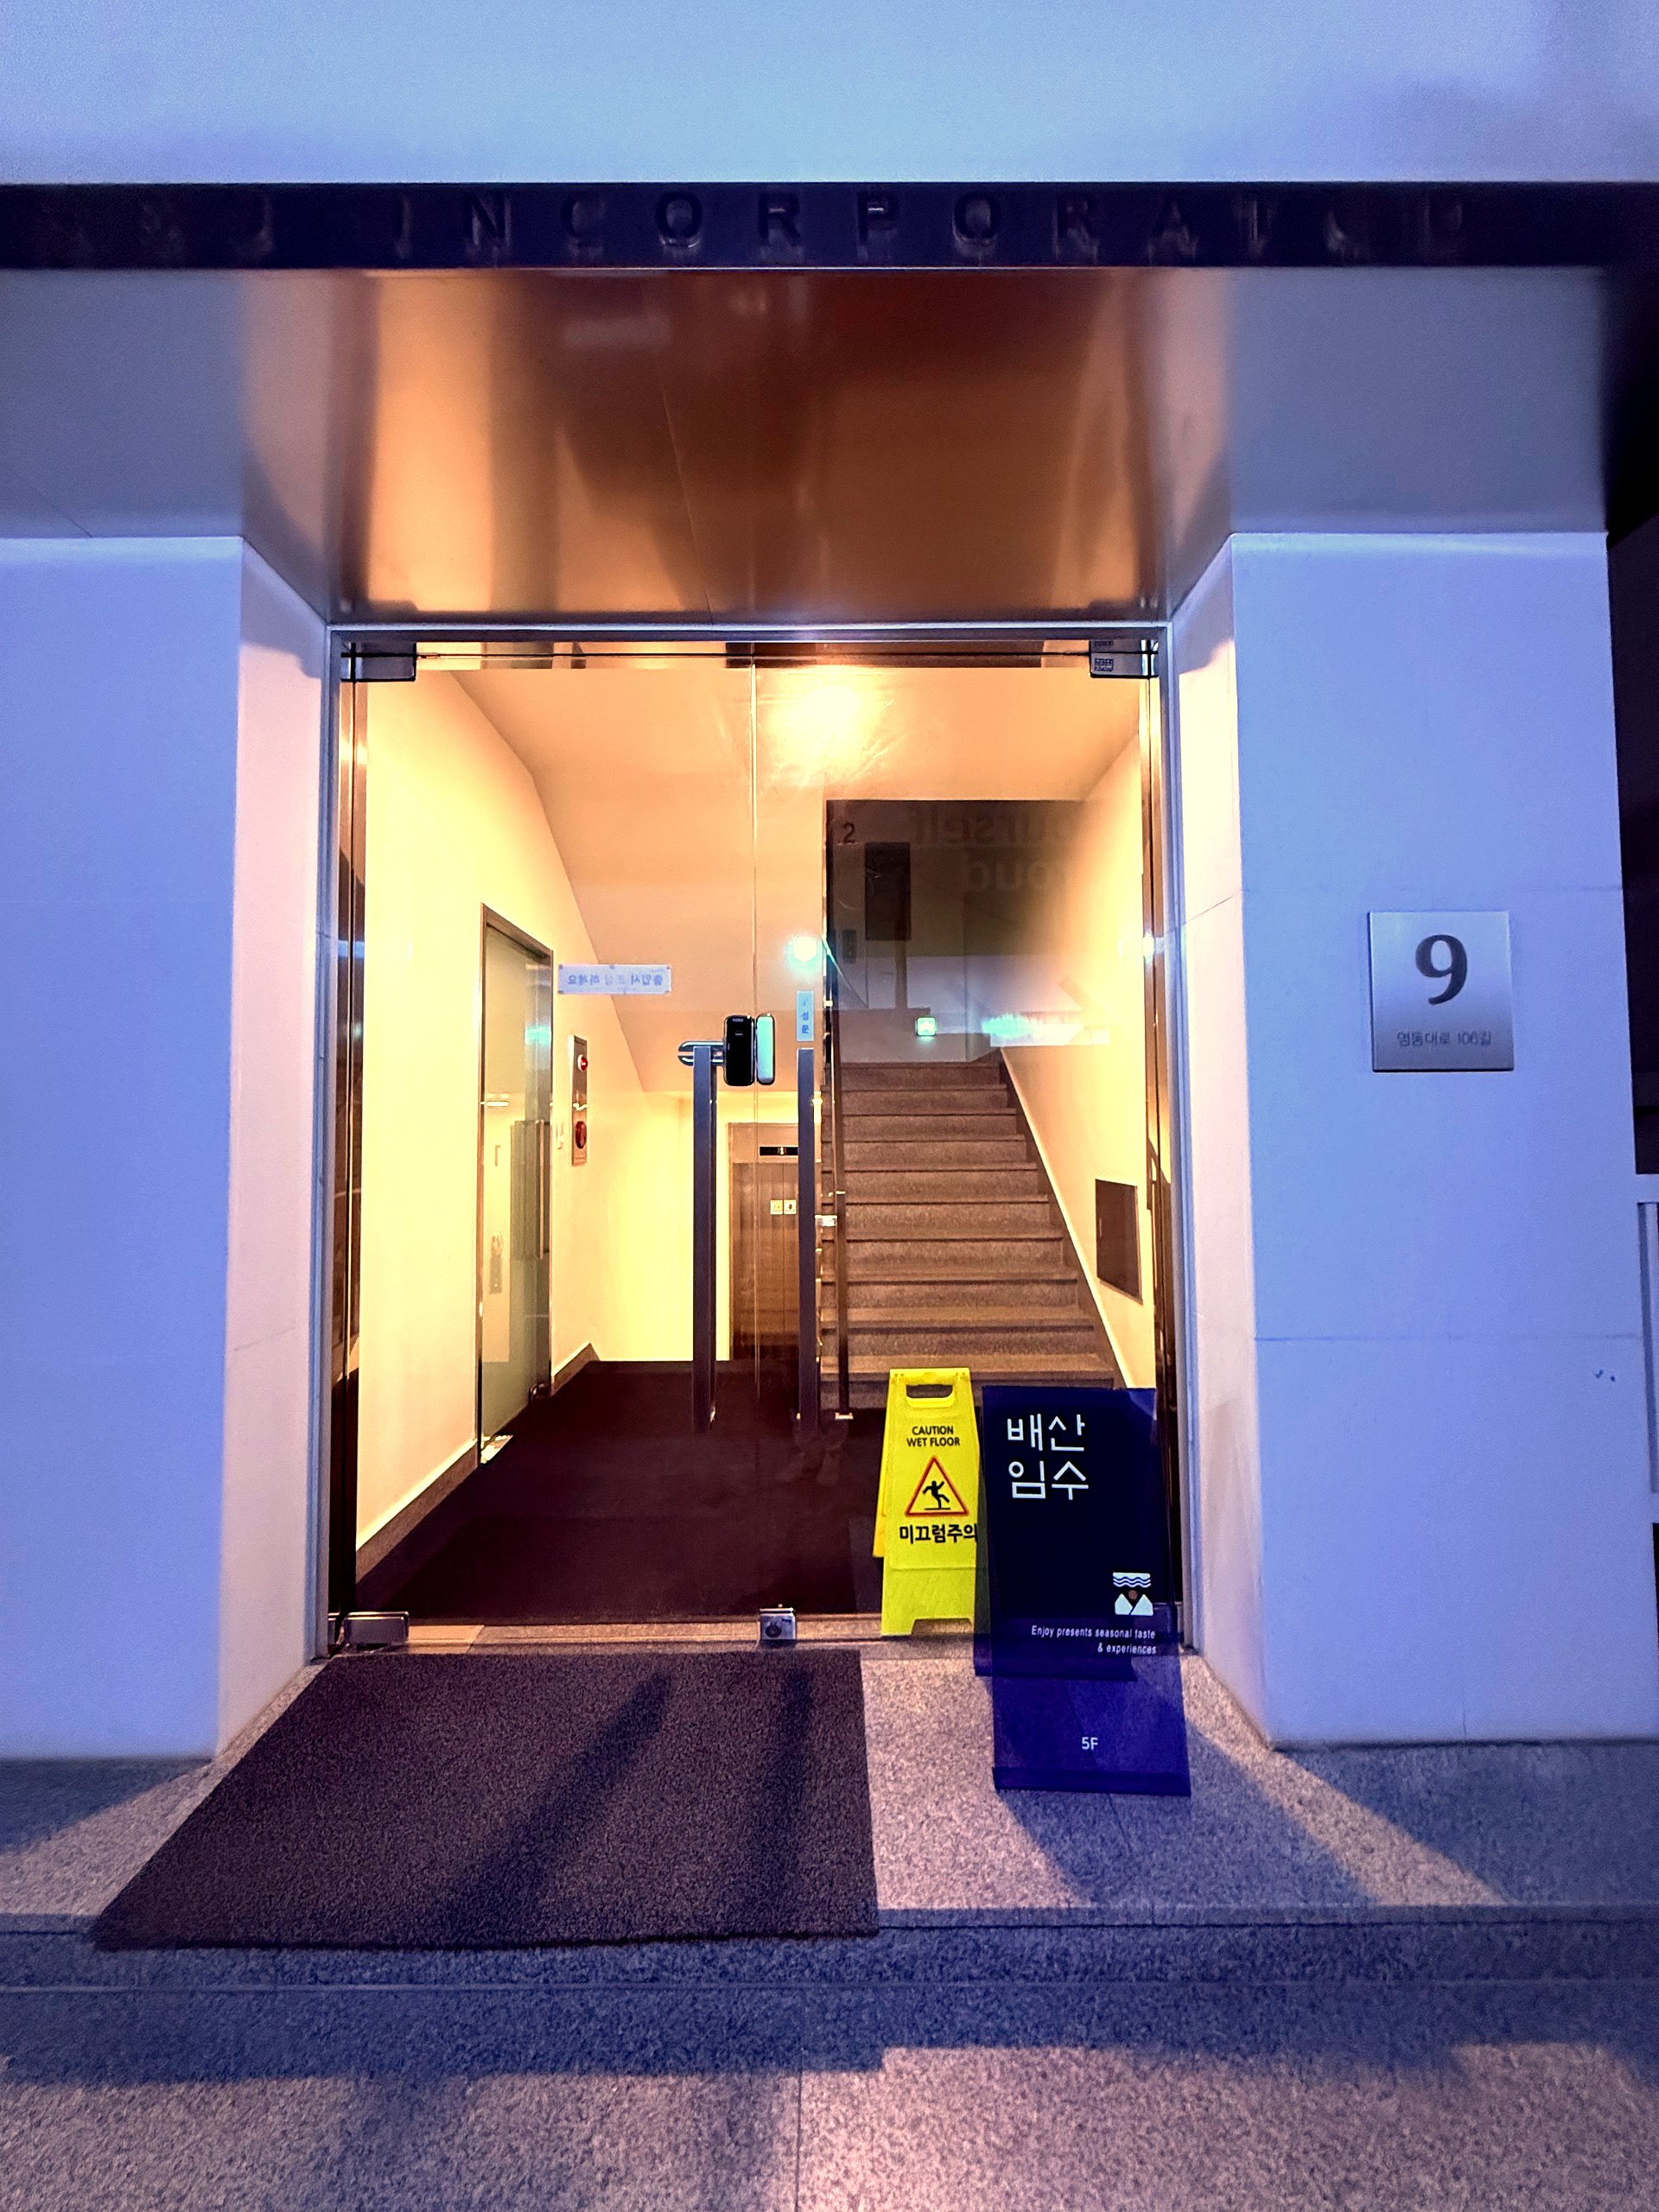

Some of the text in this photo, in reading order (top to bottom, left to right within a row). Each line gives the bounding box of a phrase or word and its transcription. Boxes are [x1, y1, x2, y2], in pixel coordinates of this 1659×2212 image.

[843, 823, 856, 843] 2
[1415, 934, 1467, 1006] 9
[912, 1426, 954, 1435] CAUTION
[1007, 1413, 1085, 1452] 배산
[906, 1437, 961, 1447] WET FLOOR
[1008, 1460, 1089, 1501] 임수
[899, 1523, 978, 1544] 미끄럼주의
[1031, 1624, 1156, 1640] Enjoy presents seasonal taste
[1097, 1642, 1157, 1655] & experiences
[1082, 1736, 1098, 1751] 5F
